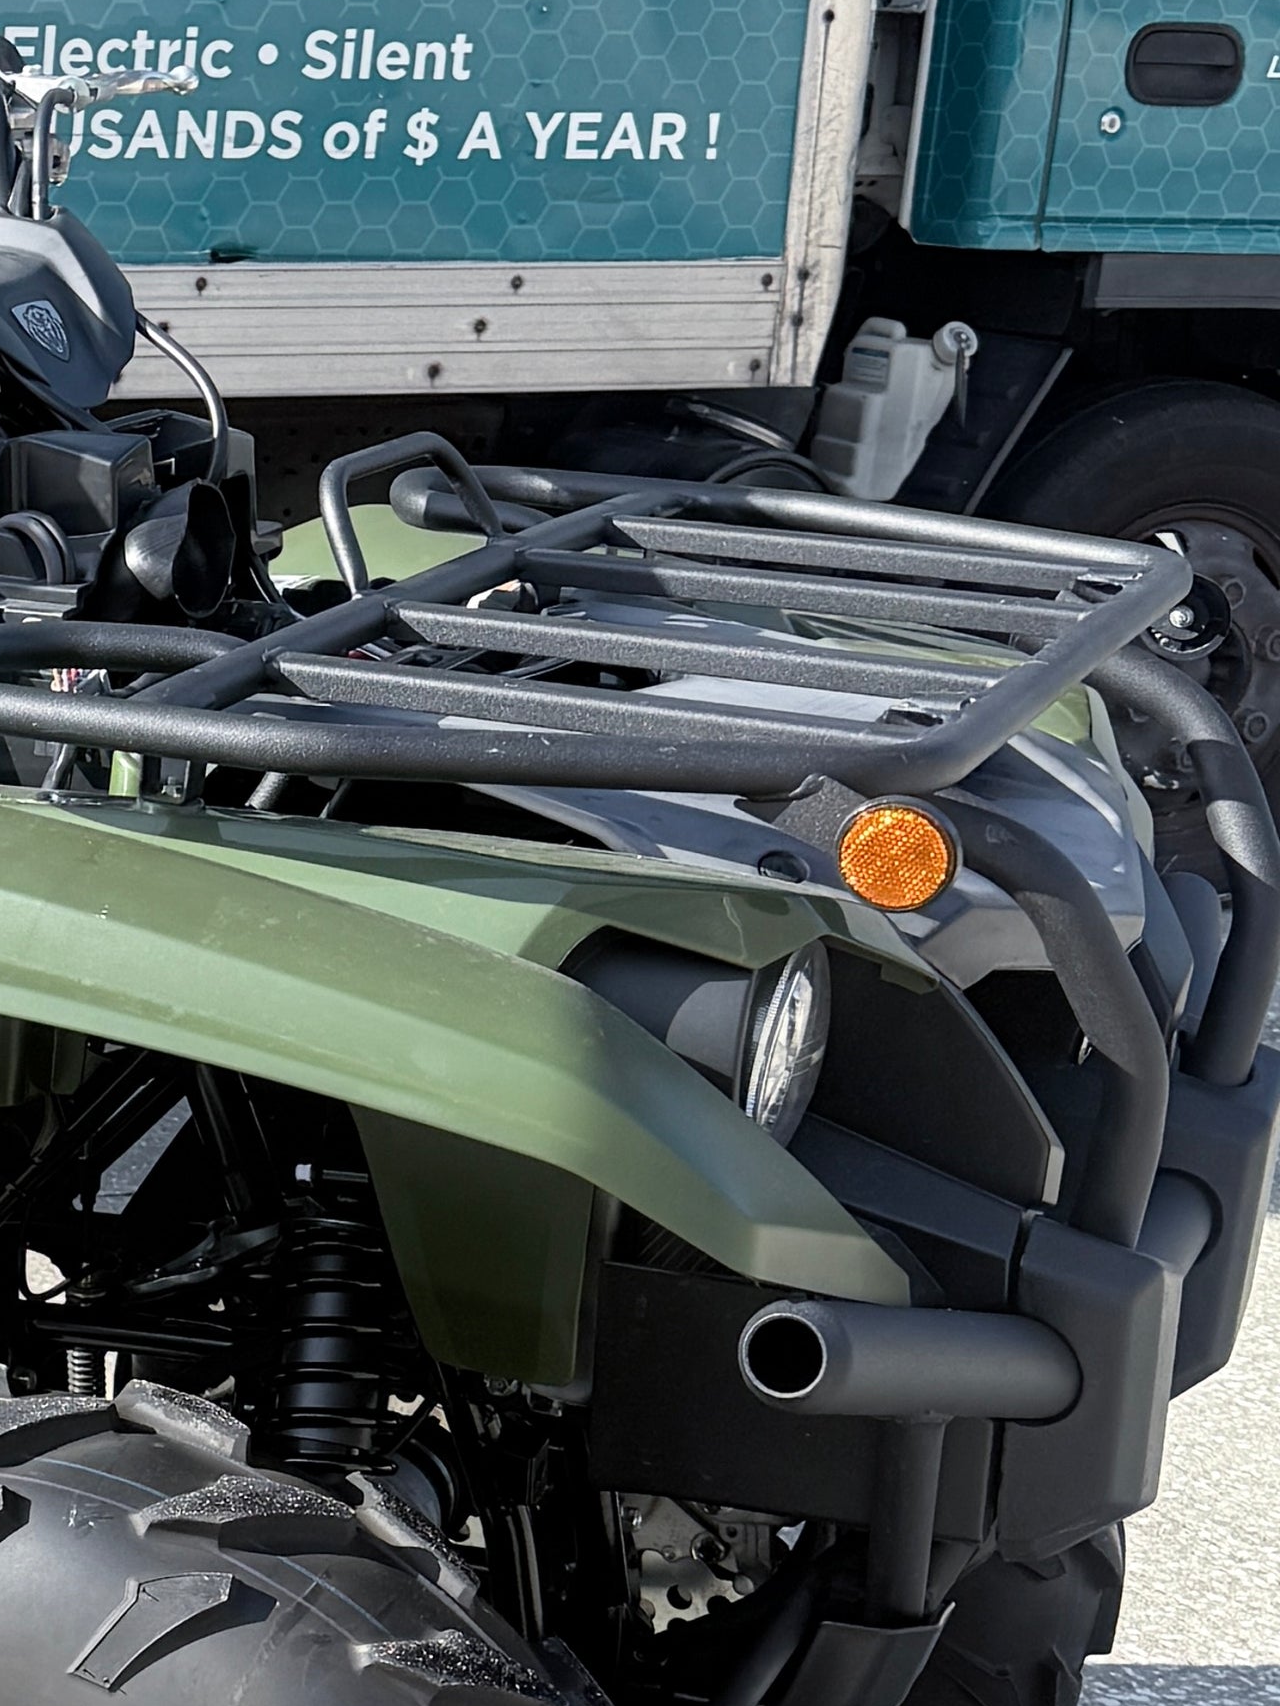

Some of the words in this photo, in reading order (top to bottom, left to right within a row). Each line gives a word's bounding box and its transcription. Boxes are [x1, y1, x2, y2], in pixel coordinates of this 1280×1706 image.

[302, 30, 473, 81] Silent
[324, 109, 387, 160] of
[403, 107, 439, 166] $
[458, 111, 501, 159] A
[526, 112, 686, 160] YEAR
